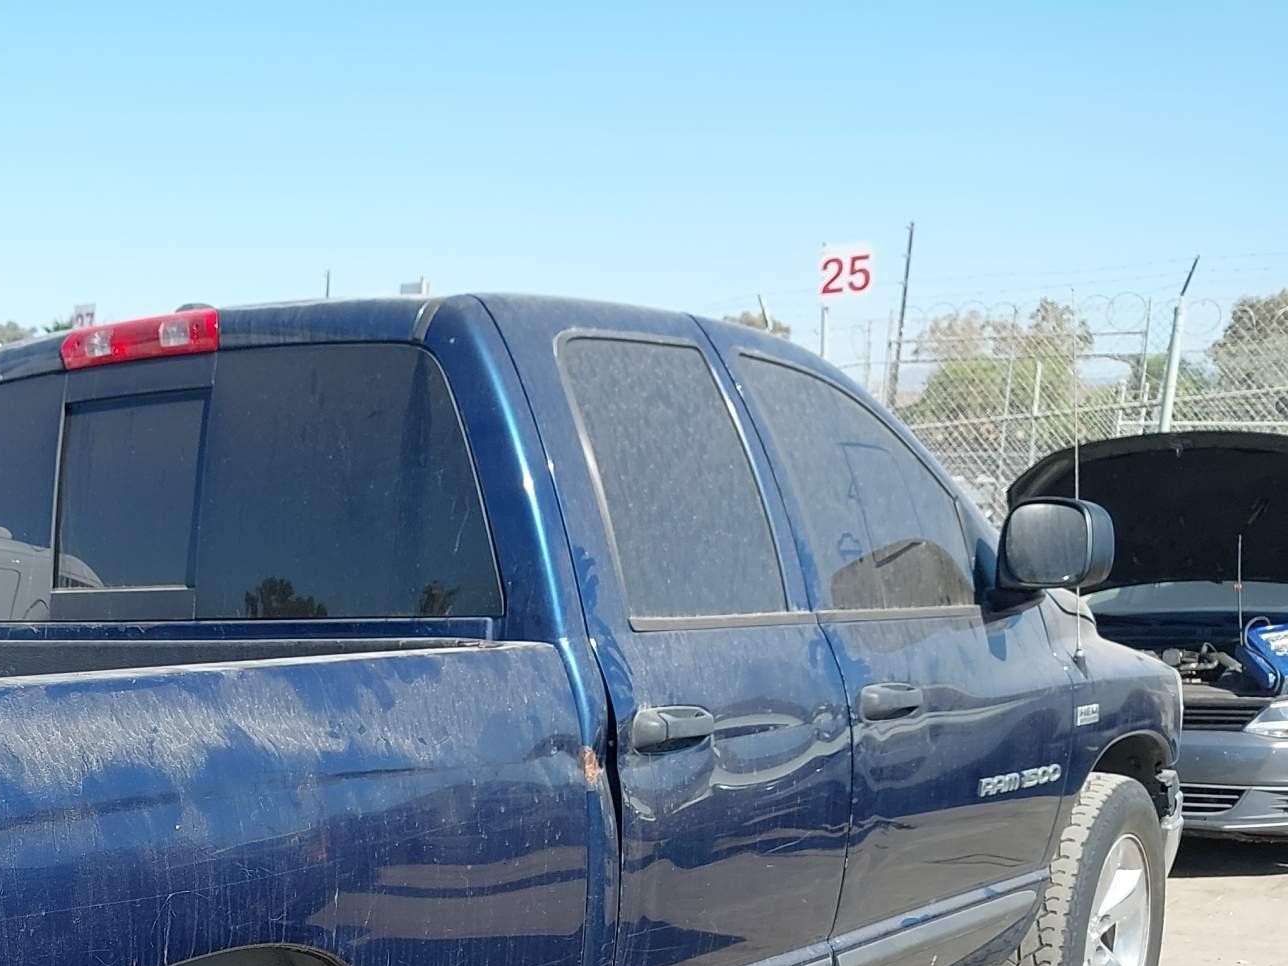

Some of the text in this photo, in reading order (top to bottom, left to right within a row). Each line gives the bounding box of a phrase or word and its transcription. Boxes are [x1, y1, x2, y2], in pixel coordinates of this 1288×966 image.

[821, 254, 870, 294] 25
[977, 763, 1061, 797] RAM 1500
